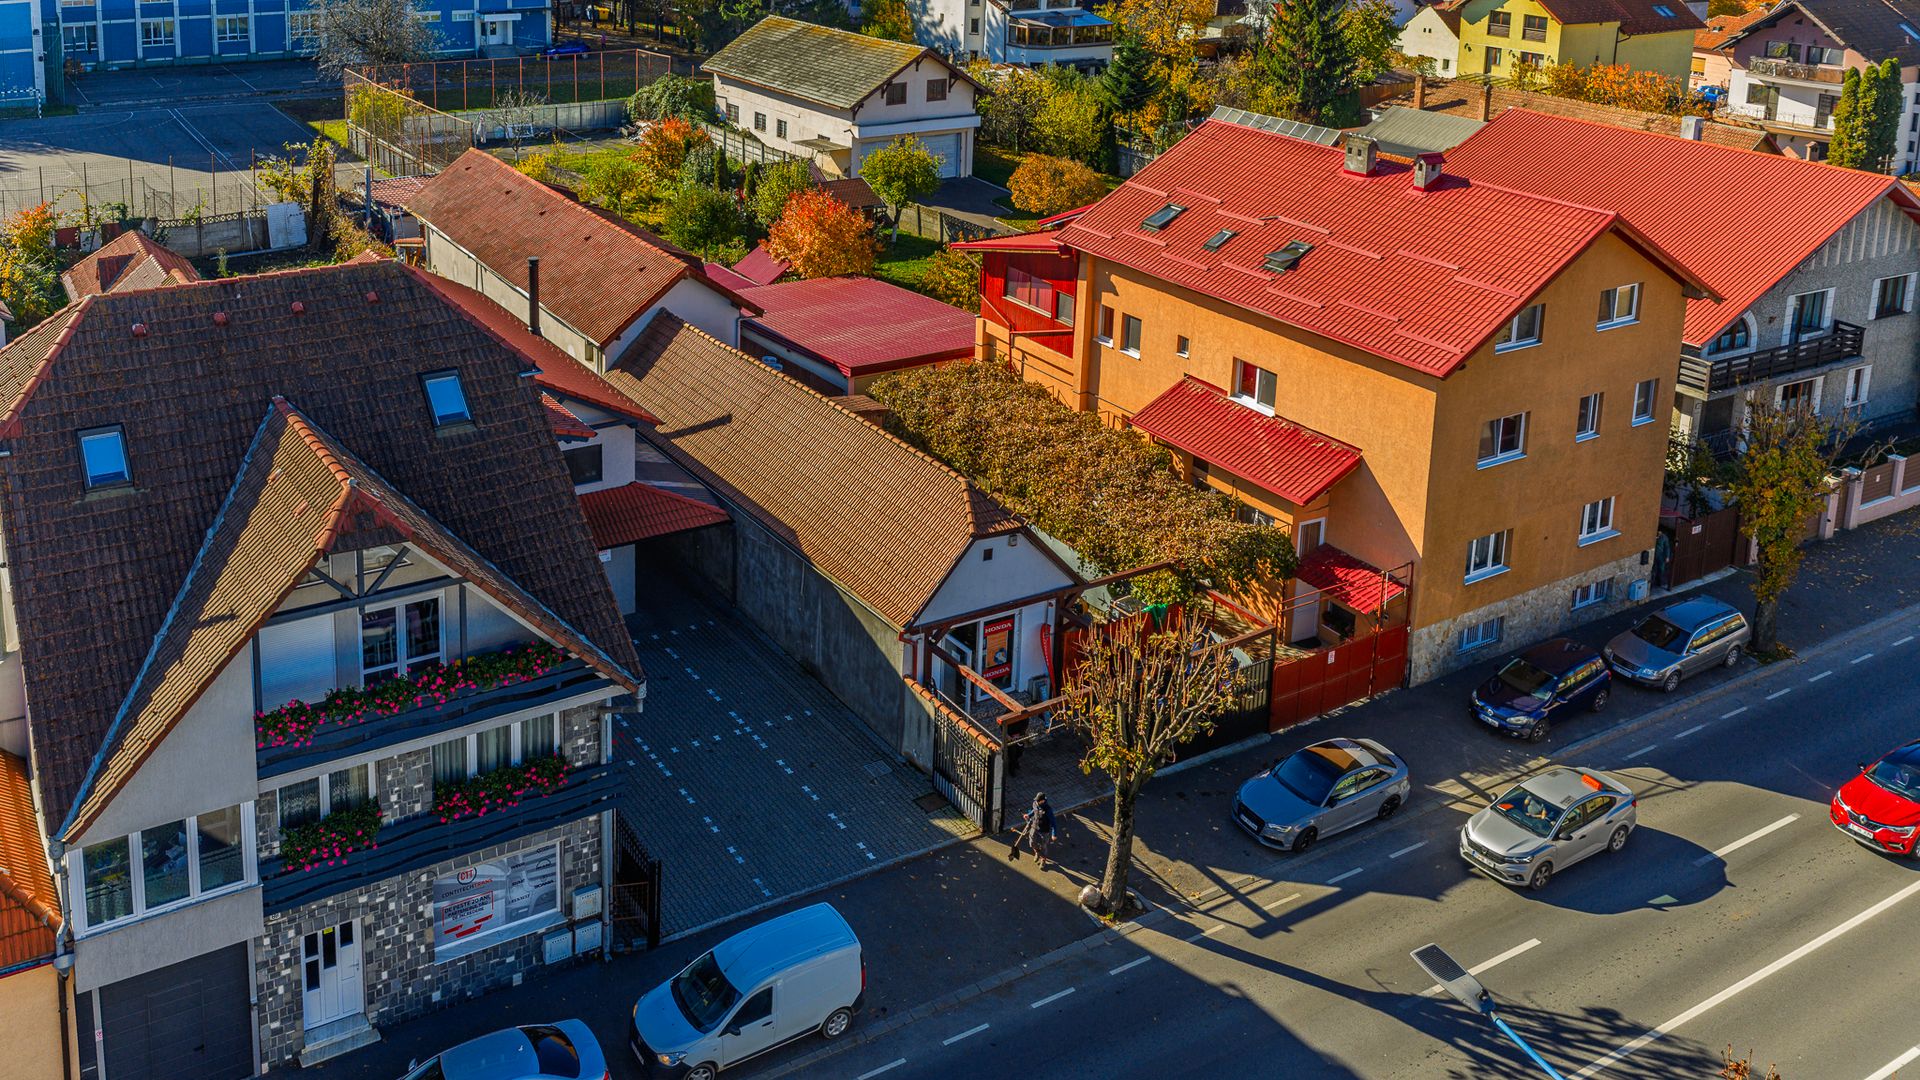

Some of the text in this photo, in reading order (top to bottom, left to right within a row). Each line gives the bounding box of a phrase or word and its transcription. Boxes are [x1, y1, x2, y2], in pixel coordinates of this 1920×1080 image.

[985, 623, 1012, 633] HONDA
[983, 667, 1009, 678] HONDA
[460, 869, 473, 881] CTT
